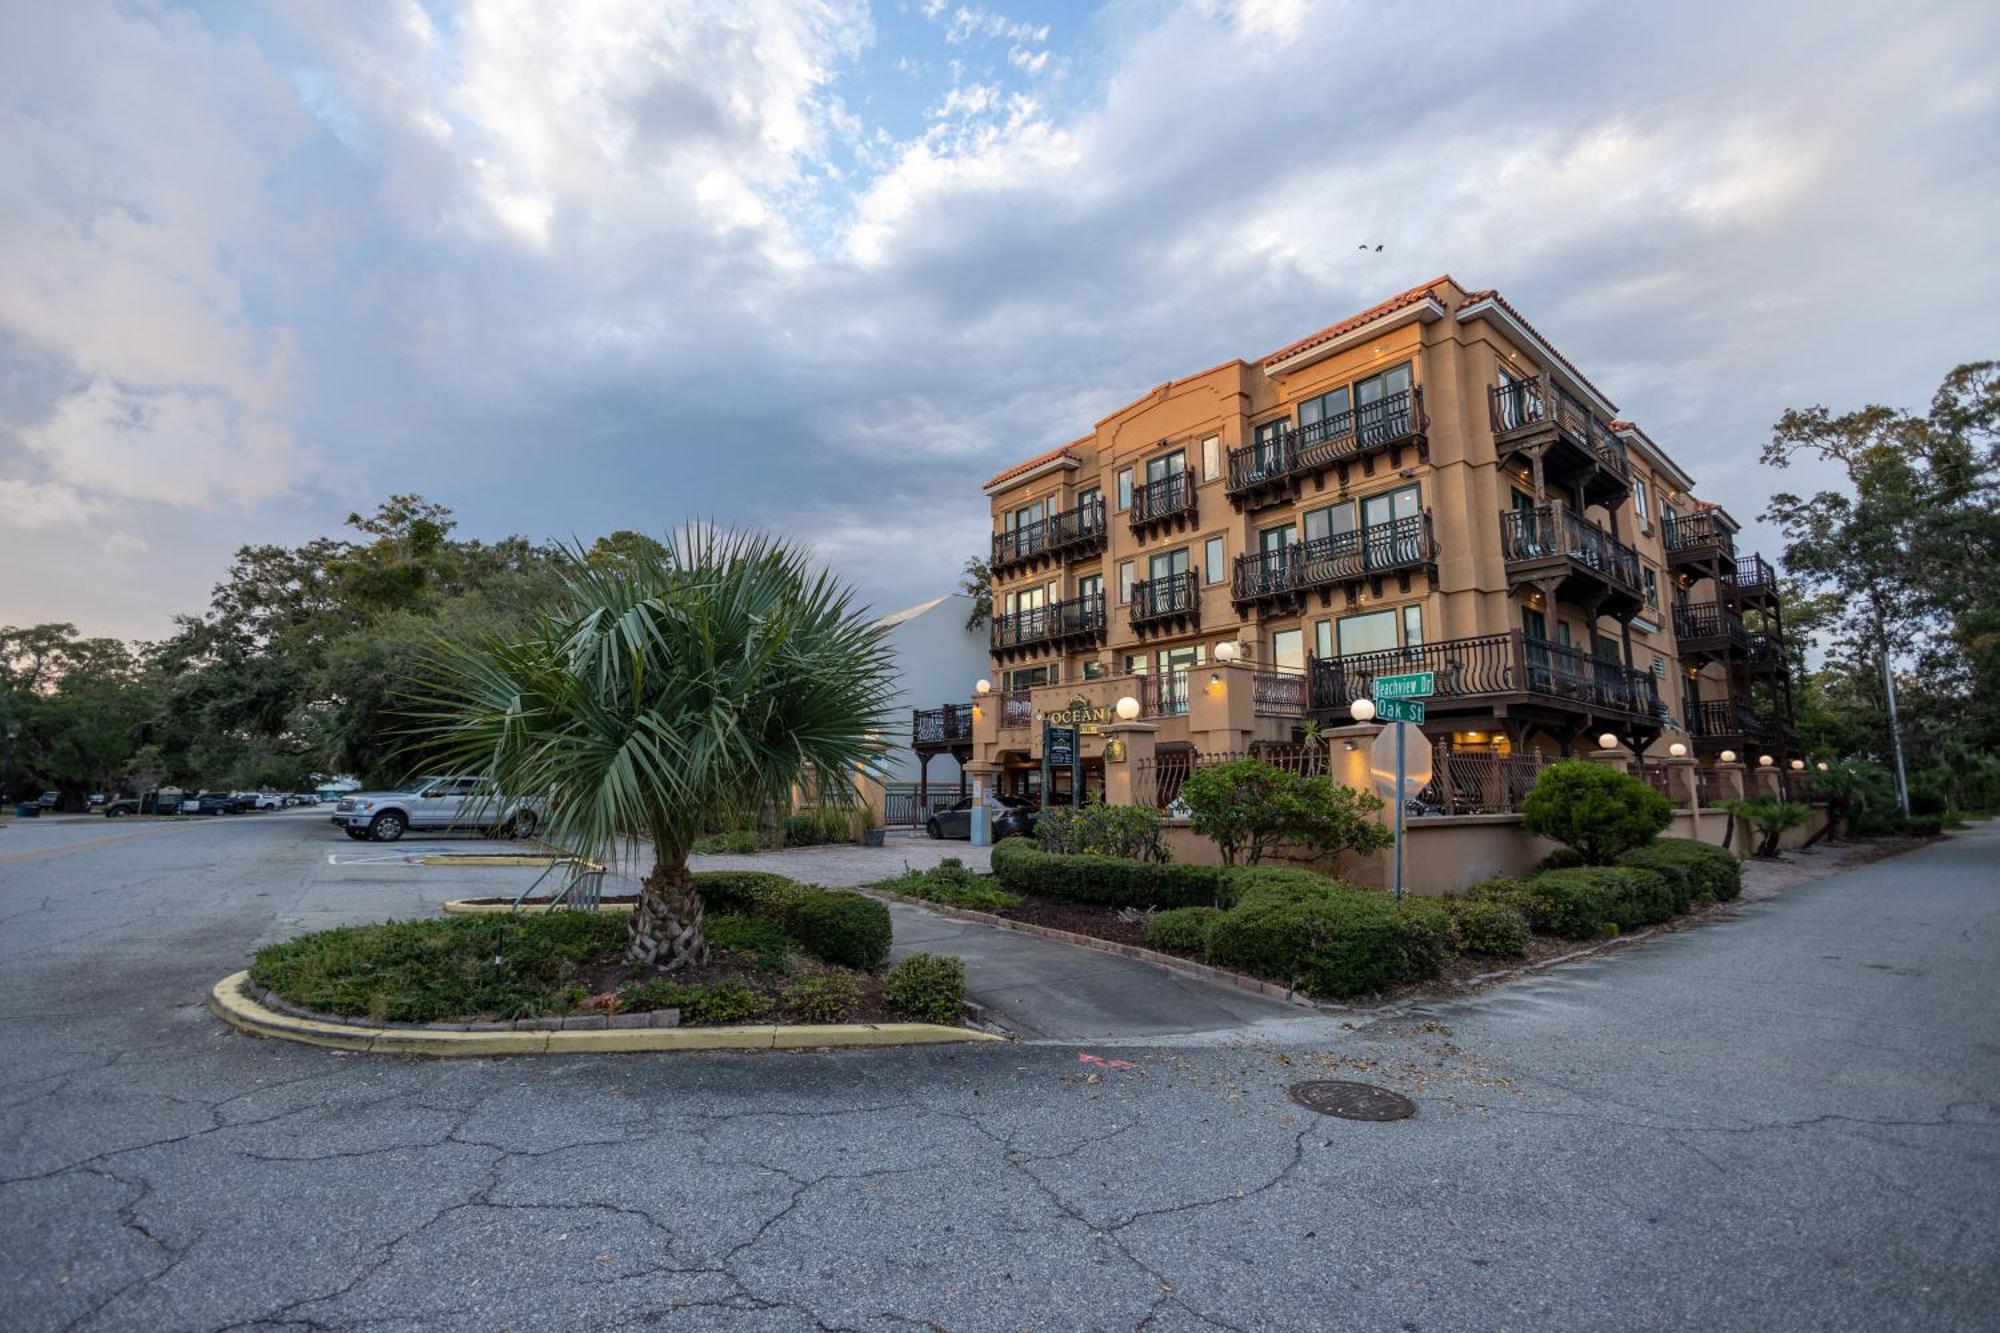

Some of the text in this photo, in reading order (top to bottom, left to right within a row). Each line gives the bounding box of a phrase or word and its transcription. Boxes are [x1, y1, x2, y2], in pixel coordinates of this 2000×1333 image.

[1375, 676, 1431, 697] Beachview Dr
[1051, 709, 1104, 724] OCEAN
[1378, 699, 1421, 721] Oak St
